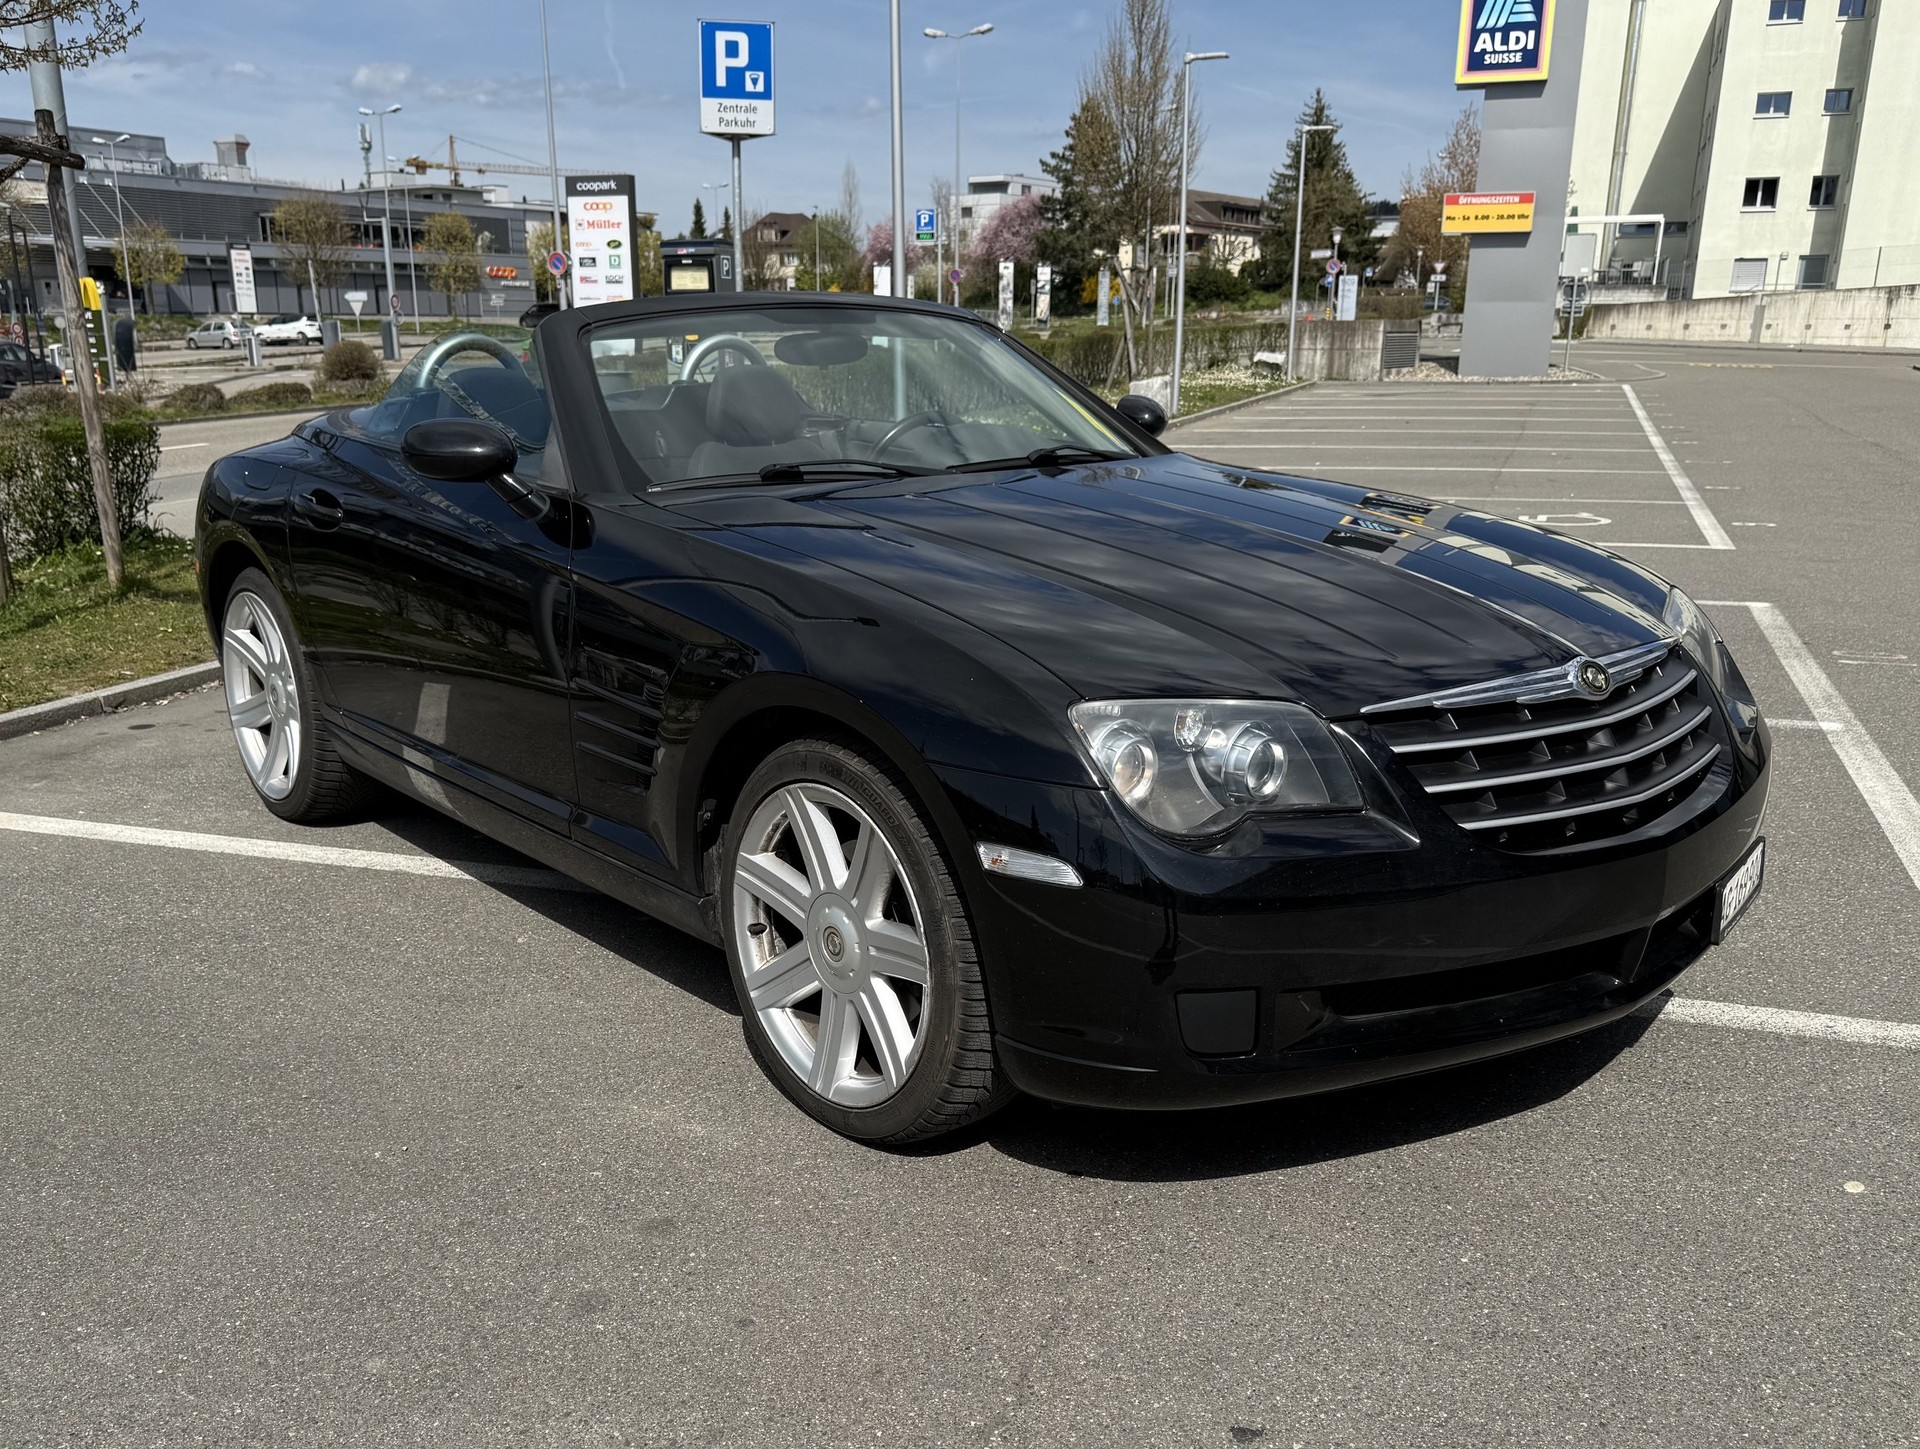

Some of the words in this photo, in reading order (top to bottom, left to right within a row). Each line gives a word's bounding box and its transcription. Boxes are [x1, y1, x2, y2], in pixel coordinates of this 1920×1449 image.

[1473, 30, 1536, 53] ALDI
[715, 30, 749, 87] P
[1483, 52, 1523, 65] SUISSE
[717, 102, 758, 114] Zentrale
[718, 116, 756, 128] Parkuhr
[576, 179, 617, 192] coopark
[1458, 194, 1520, 205] ÖFFNUNGSZEITEN
[583, 201, 613, 213] coop
[586, 219, 622, 230] Müller
[920, 213, 929, 227] P
[486, 265, 518, 279] coop
[723, 259, 729, 275] P
